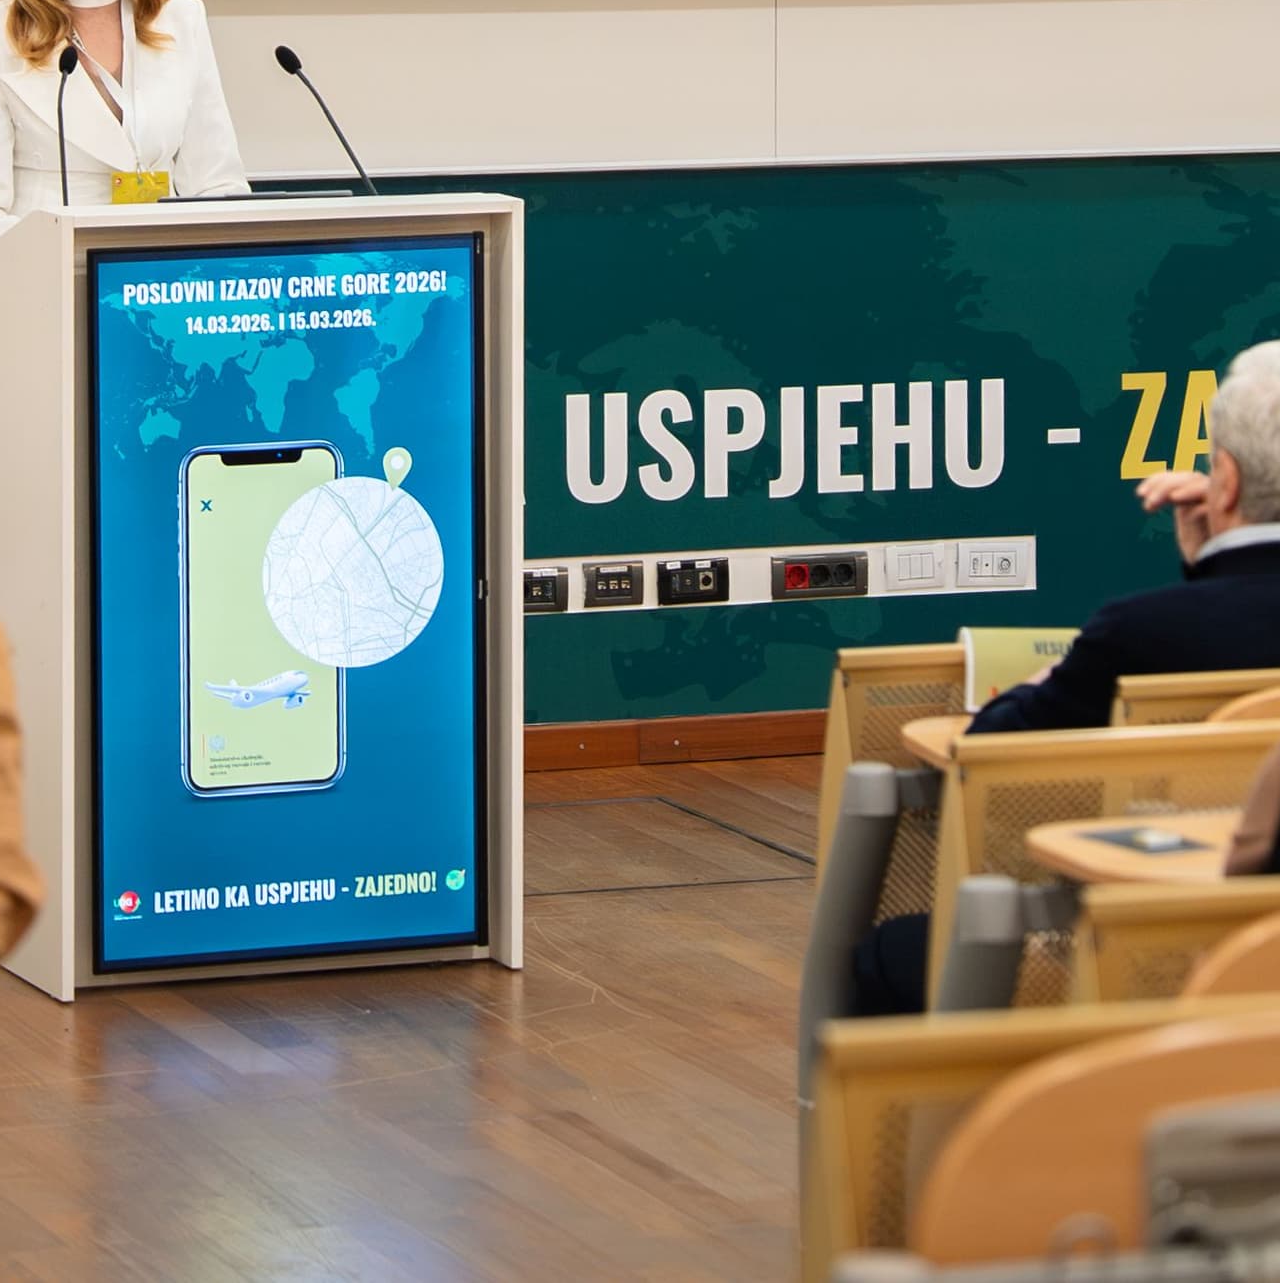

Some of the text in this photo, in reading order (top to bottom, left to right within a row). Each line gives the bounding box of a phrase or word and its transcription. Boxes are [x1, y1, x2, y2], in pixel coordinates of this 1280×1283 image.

[123, 270, 447, 306] POSLOVNI IZAZOV CRNE GORE 2026!
[185, 308, 377, 335] 14.03.2026. I 15.03.2026.
[565, 377, 1005, 505] USPJEHU
[1046, 427, 1081, 445] -
[153, 887, 220, 914] LETIMO
[224, 886, 250, 909] KA
[254, 878, 336, 906] USPJEHU
[354, 870, 437, 899] ZAJEDNO!
